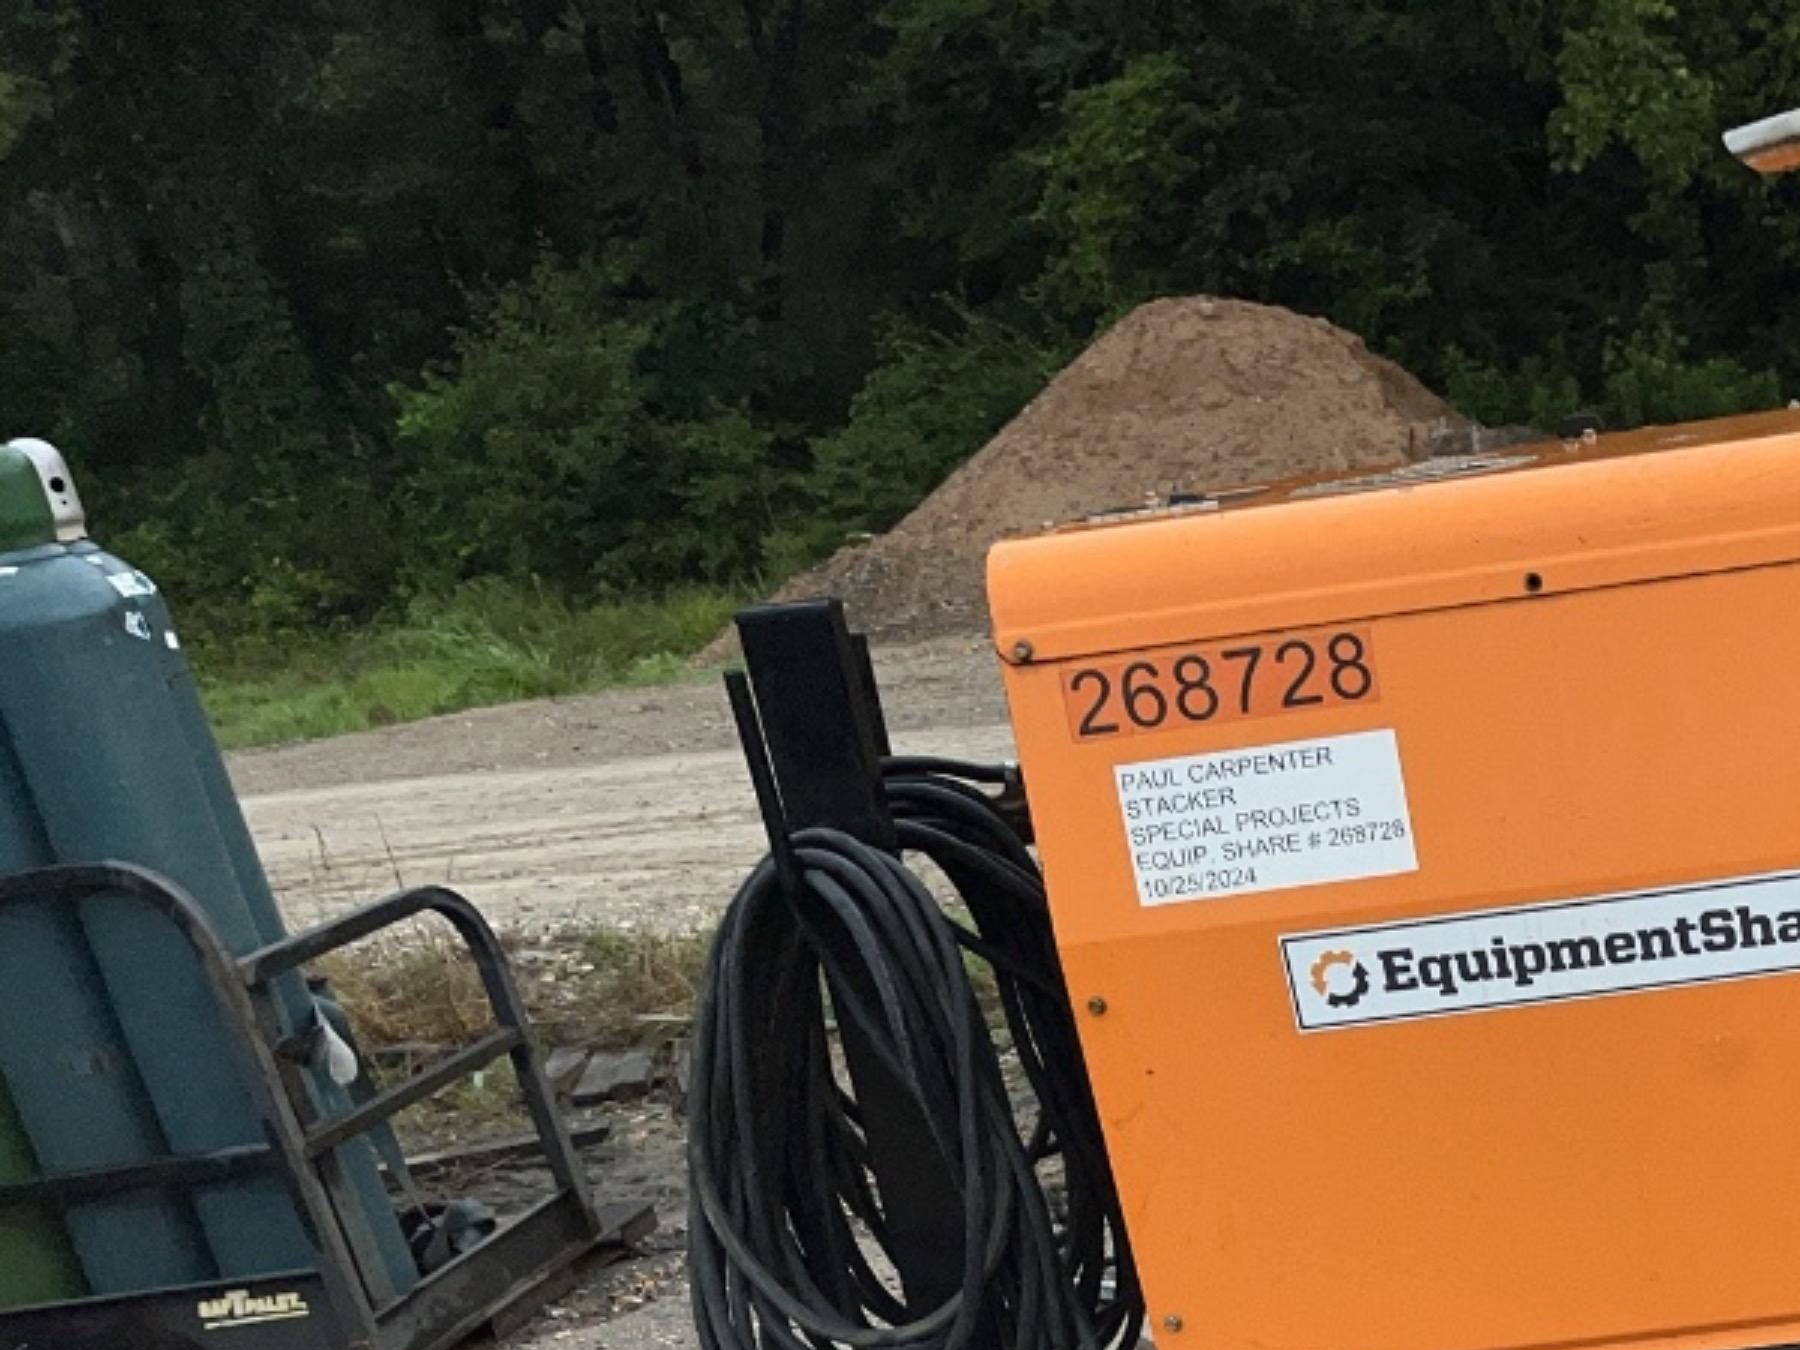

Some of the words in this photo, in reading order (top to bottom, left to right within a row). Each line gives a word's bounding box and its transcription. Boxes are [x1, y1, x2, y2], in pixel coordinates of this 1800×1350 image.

[1070, 632, 1372, 736] 268728
[1121, 762, 1182, 792] PAUL
[1187, 746, 1334, 785] CARPENTER
[1127, 787, 1237, 820] STACKER
[1131, 814, 1228, 846] SPECIAL
[1236, 798, 1360, 833] PROJECTS
[1136, 843, 1217, 871] EQUIP.
[1223, 831, 1301, 862] SHARE
[1308, 831, 1322, 850] #
[1328, 819, 1405, 849] 268728
[1144, 867, 1258, 900] 10/25/2024
